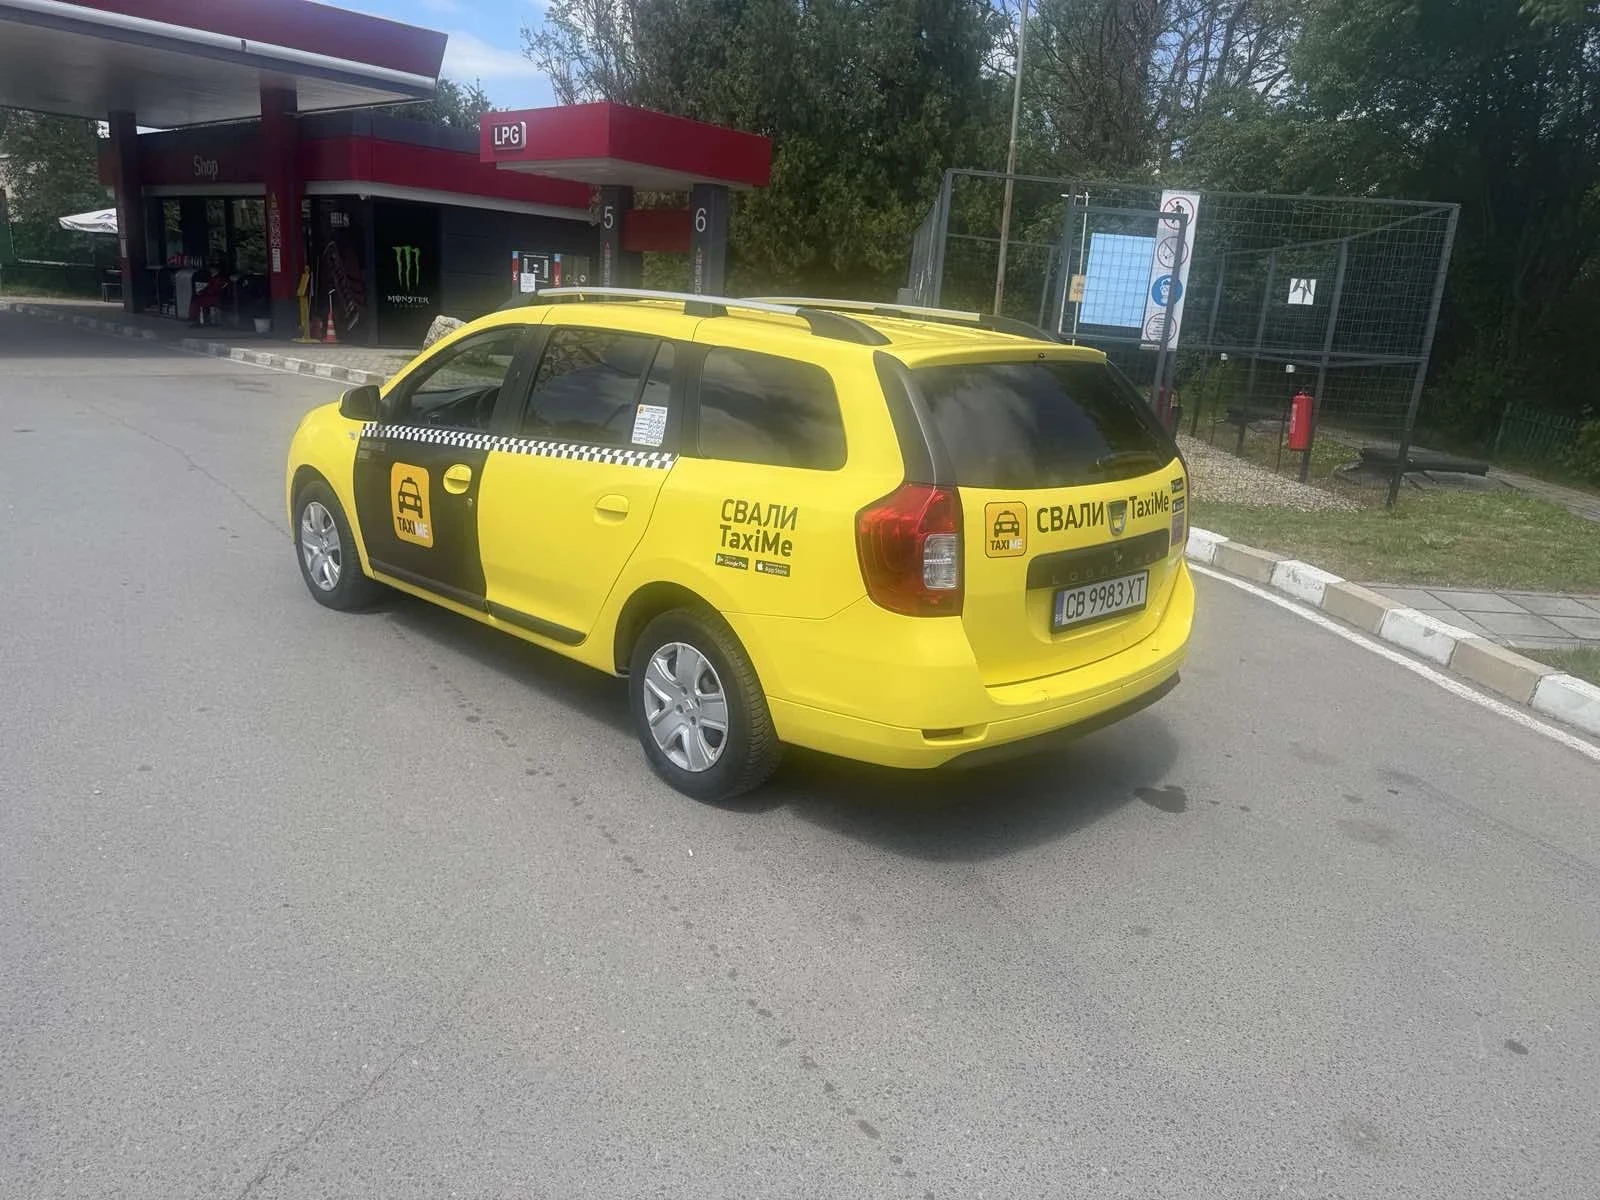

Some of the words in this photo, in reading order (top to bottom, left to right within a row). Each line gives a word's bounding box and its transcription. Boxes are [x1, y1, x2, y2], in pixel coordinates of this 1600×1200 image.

[494, 125, 520, 145] LPG
[193, 154, 218, 181] Shop
[603, 206, 614, 229] 5
[695, 207, 706, 232] 6
[387, 294, 430, 305] MONSTER
[721, 498, 799, 531] СВАЛИ
[1036, 501, 1104, 533] СВАЛИ
[1128, 490, 1169, 519] TaxiMe
[719, 524, 793, 557] TaxiMe
[1065, 590, 1086, 620] CB
[1089, 582, 1124, 614] 9983
[1126, 576, 1145, 604] XT
